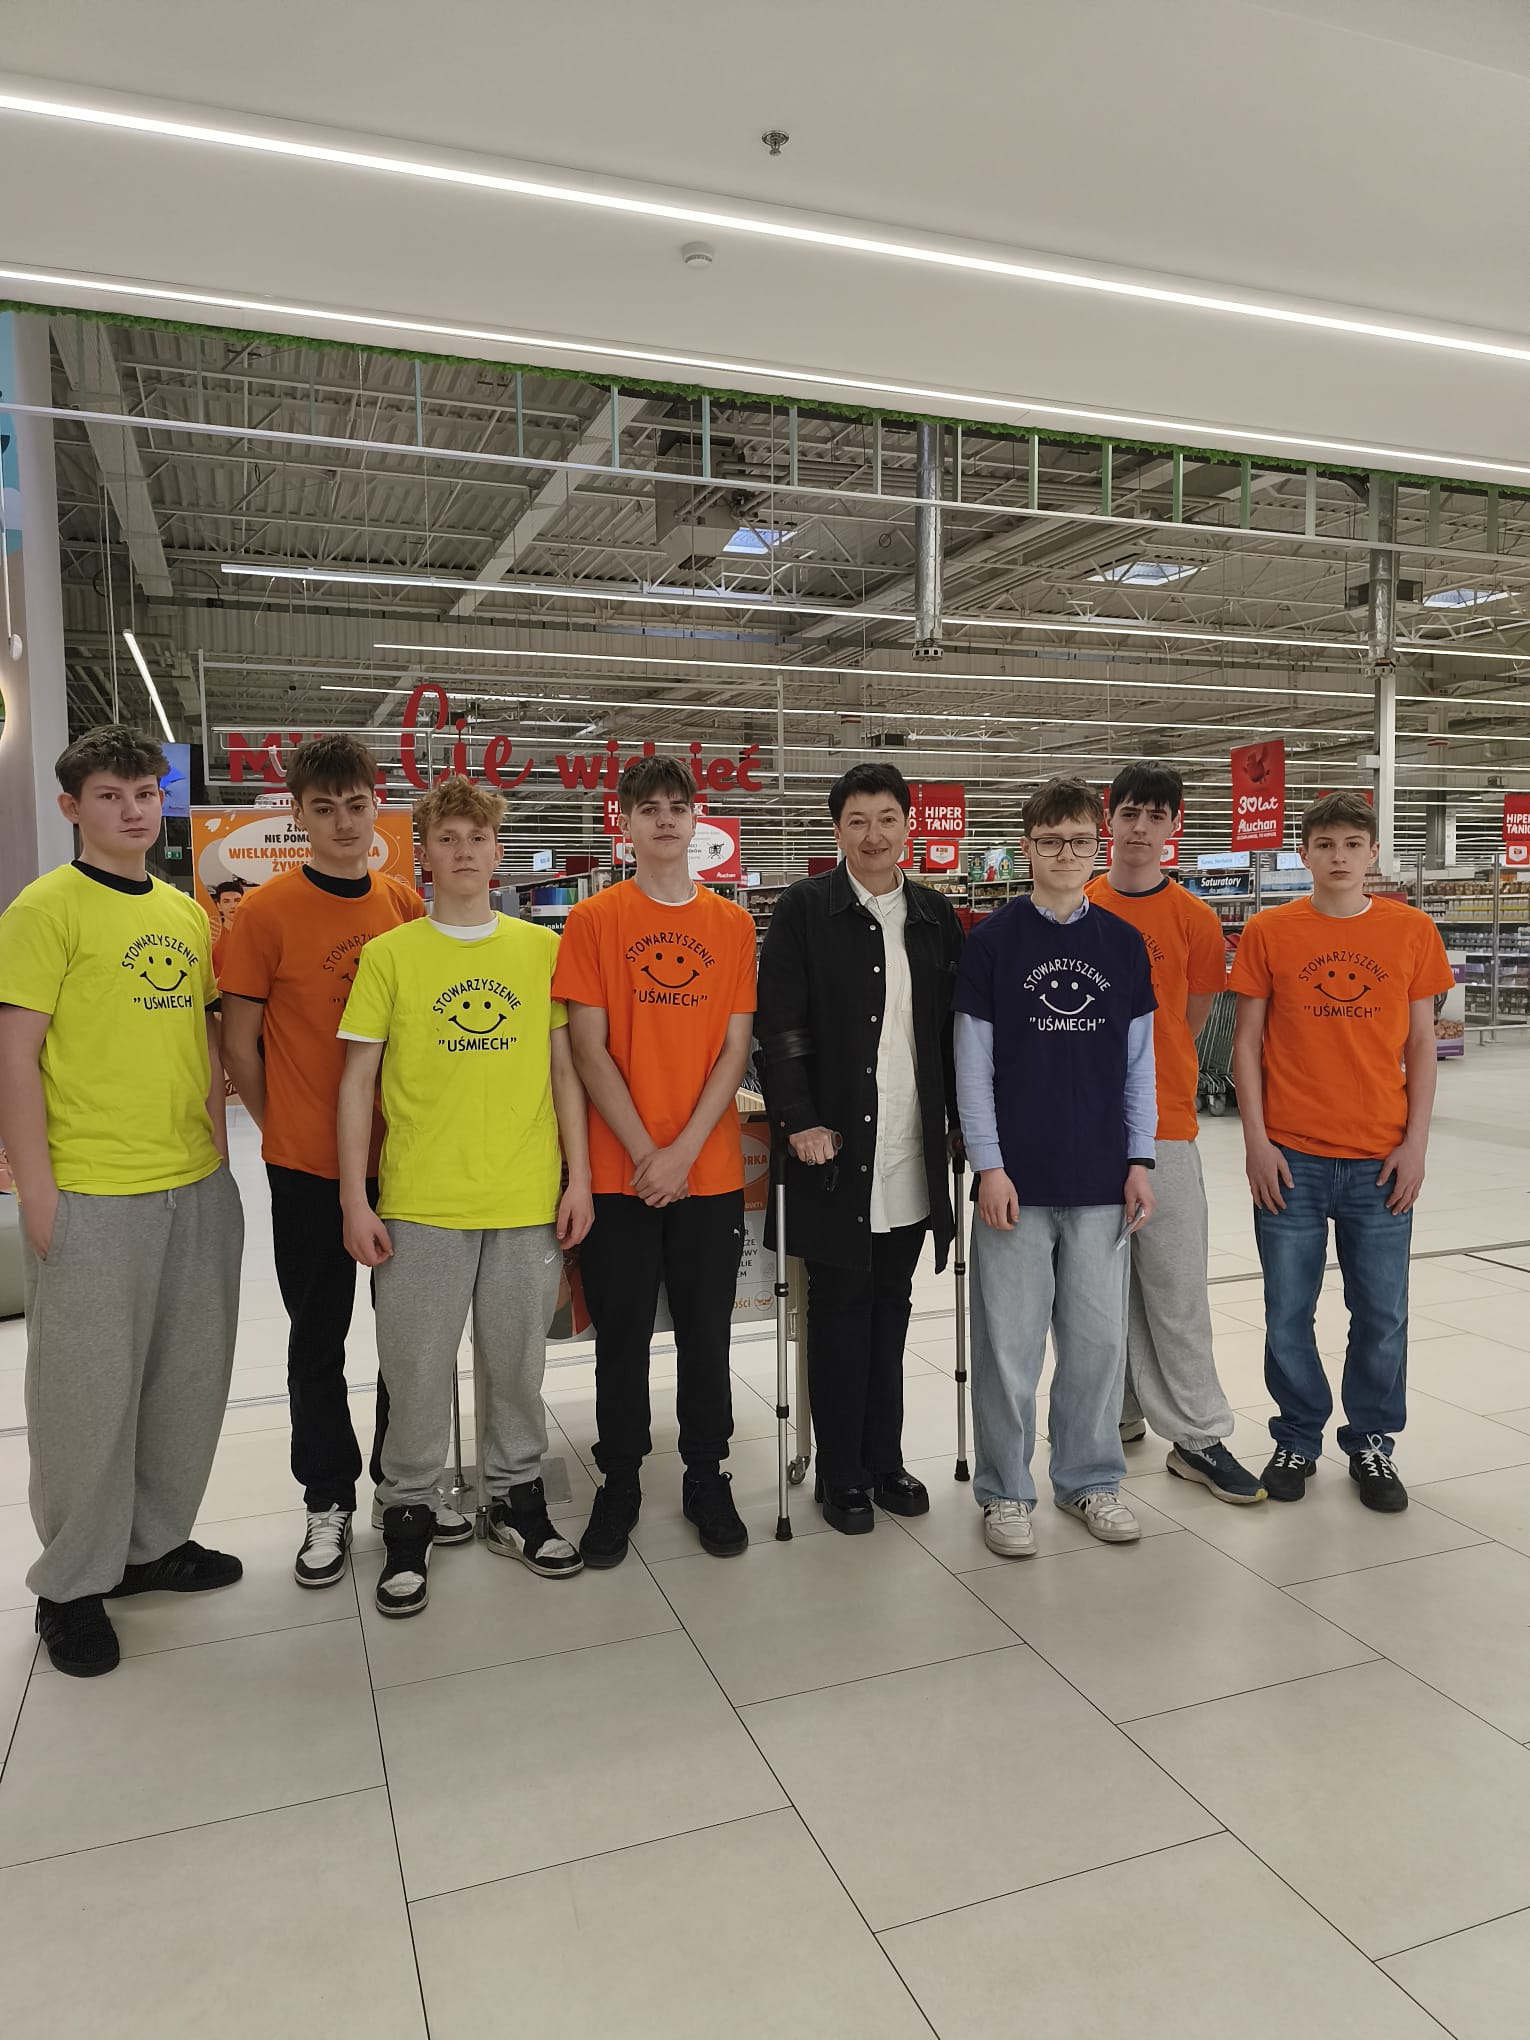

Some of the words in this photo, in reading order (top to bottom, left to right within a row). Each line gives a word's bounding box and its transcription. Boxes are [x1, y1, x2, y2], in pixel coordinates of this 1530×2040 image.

[555, 740, 762, 791] wiieć
[925, 807, 962, 818] HIPER
[925, 819, 962, 830] TANIO
[1238, 819, 1276, 832] Auchan
[264, 834, 282, 843] NIE
[1200, 876, 1241, 888] Saturatory
[121, 934, 199, 970] STOWARZYSZENIE
[625, 932, 716, 968] STOWARZYSZENIE
[1023, 958, 1111, 991] STOWARZYSZENIE
[1298, 951, 1389, 982] STOWARZYSZENIE
[432, 978, 521, 1014] STOWARZYSZENIE
[1029, 1016, 1106, 1031] "UŚMIECH"
[438, 1036, 517, 1052] "UŚMIECH"
